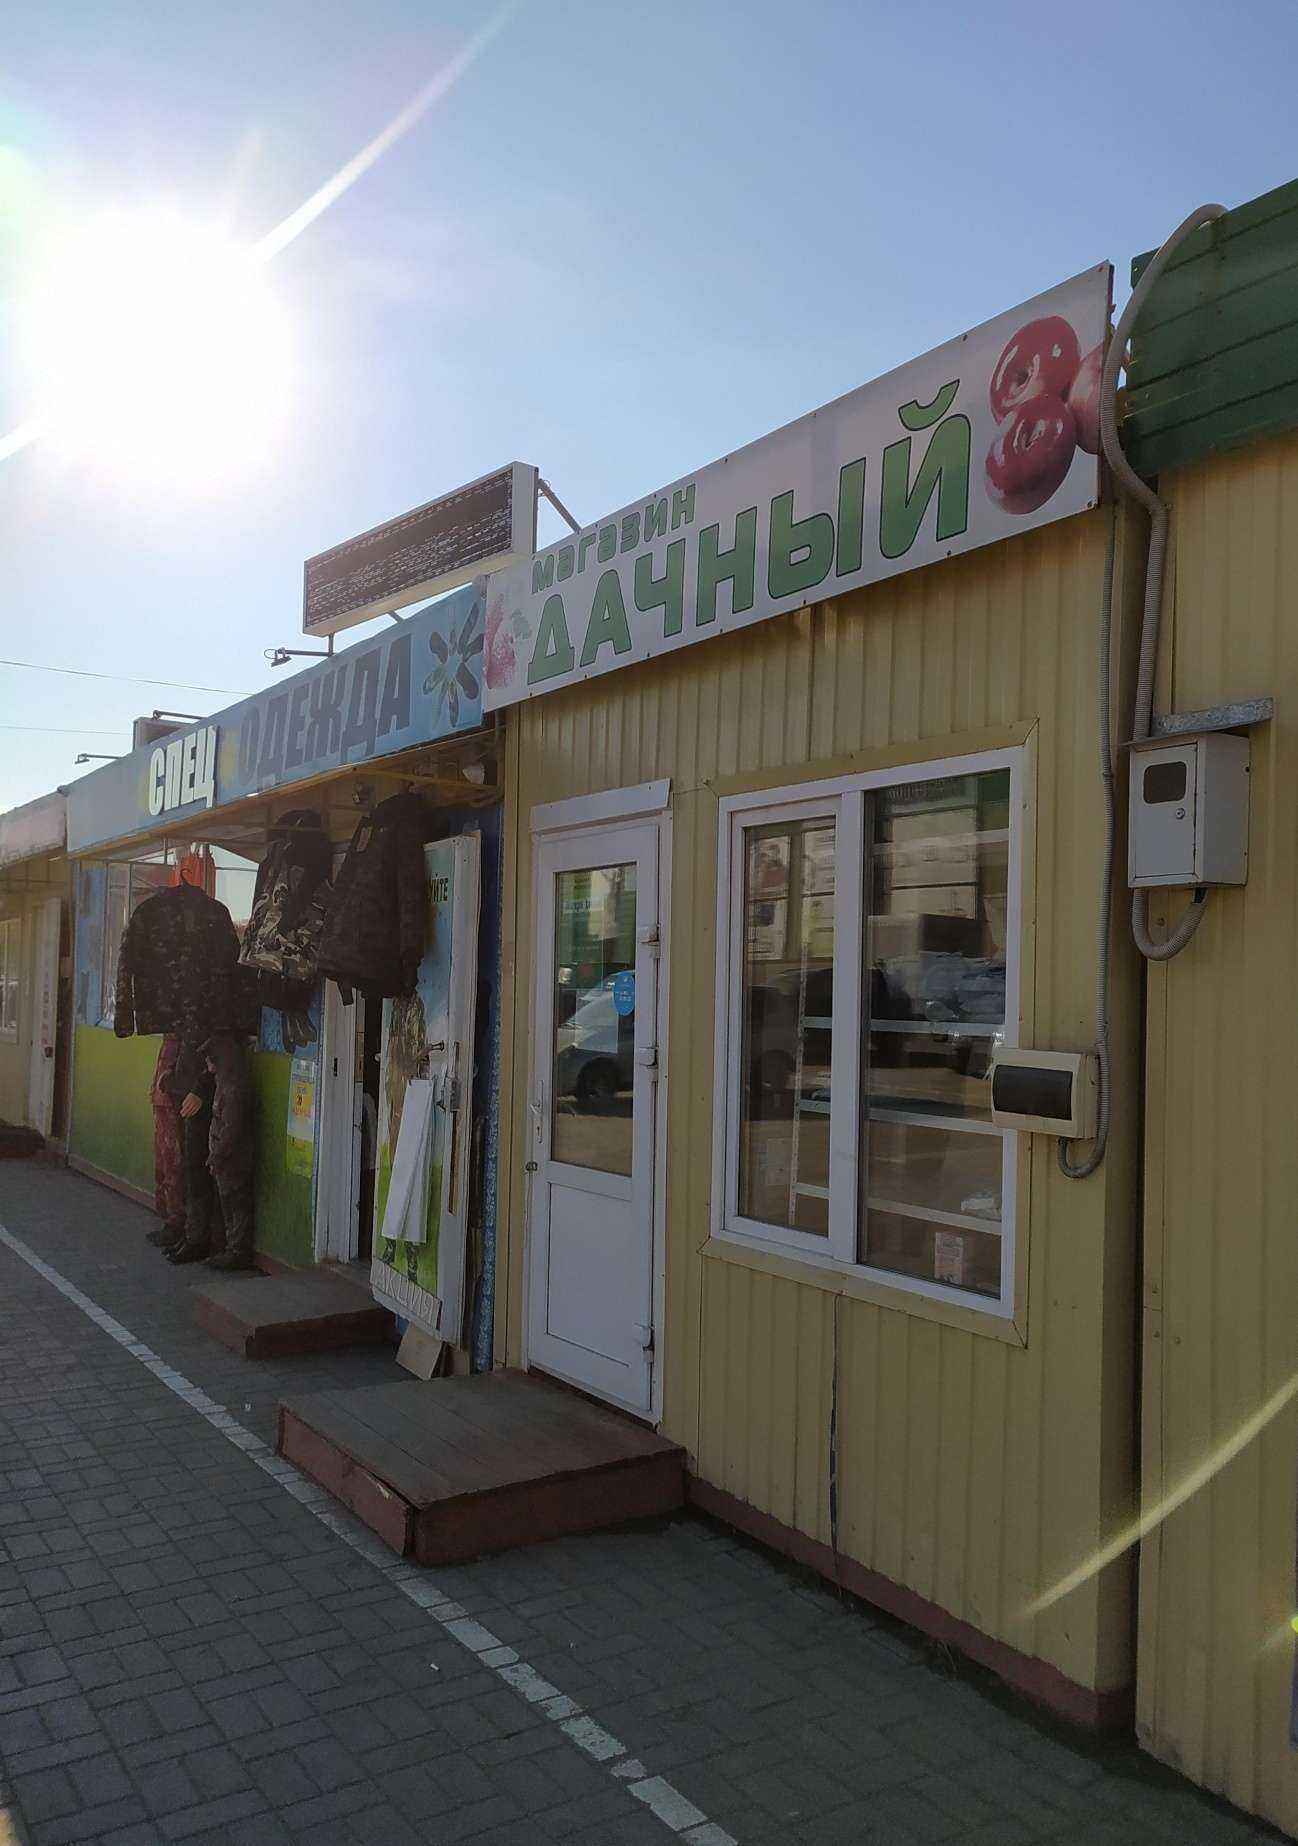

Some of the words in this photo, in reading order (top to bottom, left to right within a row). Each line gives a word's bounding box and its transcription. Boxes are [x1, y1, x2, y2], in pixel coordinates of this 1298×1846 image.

[527, 378, 972, 685] ДАЧНЫЙ
[531, 483, 696, 594] магазин
[148, 724, 219, 816] СПЕЦ
[238, 633, 414, 793] ОДЕЖДА
